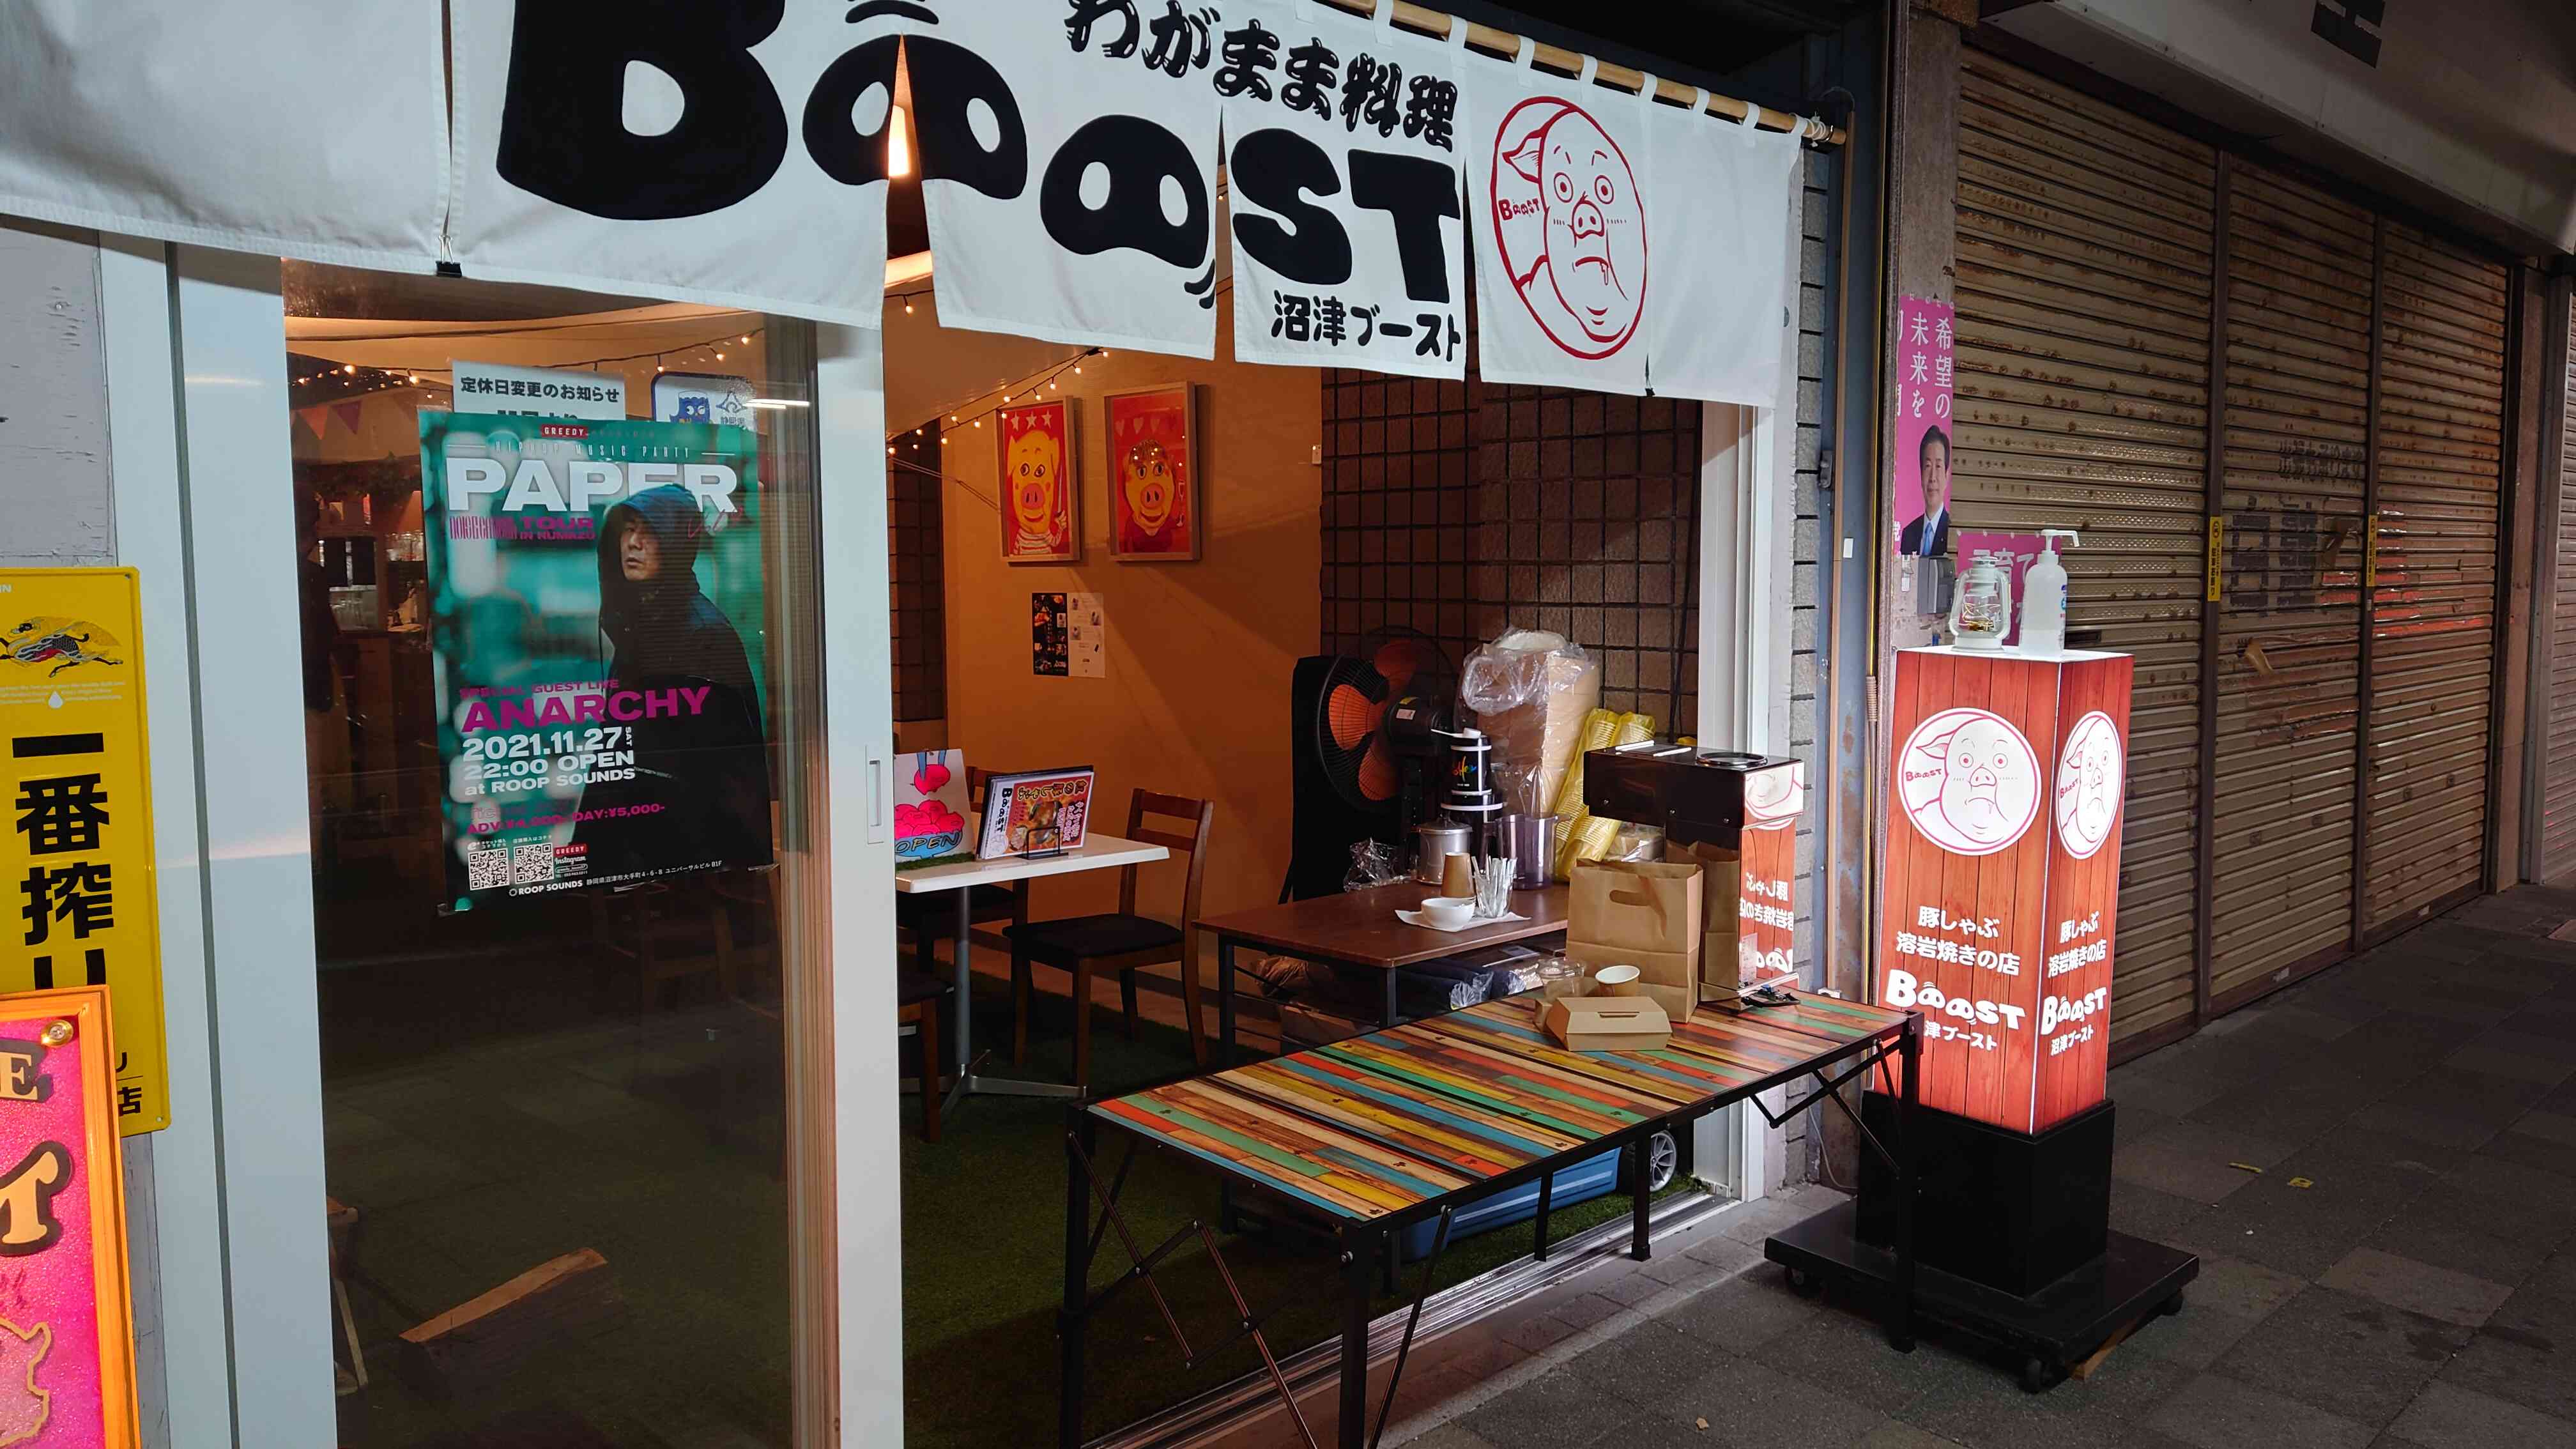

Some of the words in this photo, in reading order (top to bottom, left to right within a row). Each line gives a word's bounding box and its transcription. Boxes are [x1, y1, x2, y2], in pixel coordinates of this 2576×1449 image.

[1064, 0, 1458, 152] わがまま料理
[1271, 289, 1460, 362] 沼津ブースト
[1910, 311, 1929, 418] 未来を
[1935, 316, 1952, 419] 希望の
[461, 376, 620, 403] 定休日変更のお知らせ
[544, 426, 585, 436] GREEDY
[576, 444, 626, 457] MUSIC
[446, 457, 738, 513] PAPER
[521, 516, 594, 530] TOUR
[532, 681, 582, 693] GUEST
[588, 679, 620, 689] LIVE
[461, 686, 711, 733] ANARCHY
[462, 726, 623, 762] 2021.11.27
[463, 758, 549, 781] 22:00
[557, 750, 634, 772] OPEN
[464, 782, 486, 796] at
[491, 777, 550, 793] ROOP
[556, 767, 636, 786] SOUNDS
[894, 829, 960, 852] OPEN
[554, 855, 586, 866] Instagram
[518, 885, 544, 895] ROOP
[546, 880, 583, 892] SOUNDS
[1918, 905, 2000, 939] 豚しゃぶ
[2059, 910, 2099, 944] 豚しゃぶ
[1896, 931, 2021, 976] 溶岩焼きの店
[2047, 939, 2107, 978] 溶岩焼きの店
[1924, 1020, 1997, 1051] 津ブースト
[2051, 1024, 2094, 1056] 沼津ブースト
